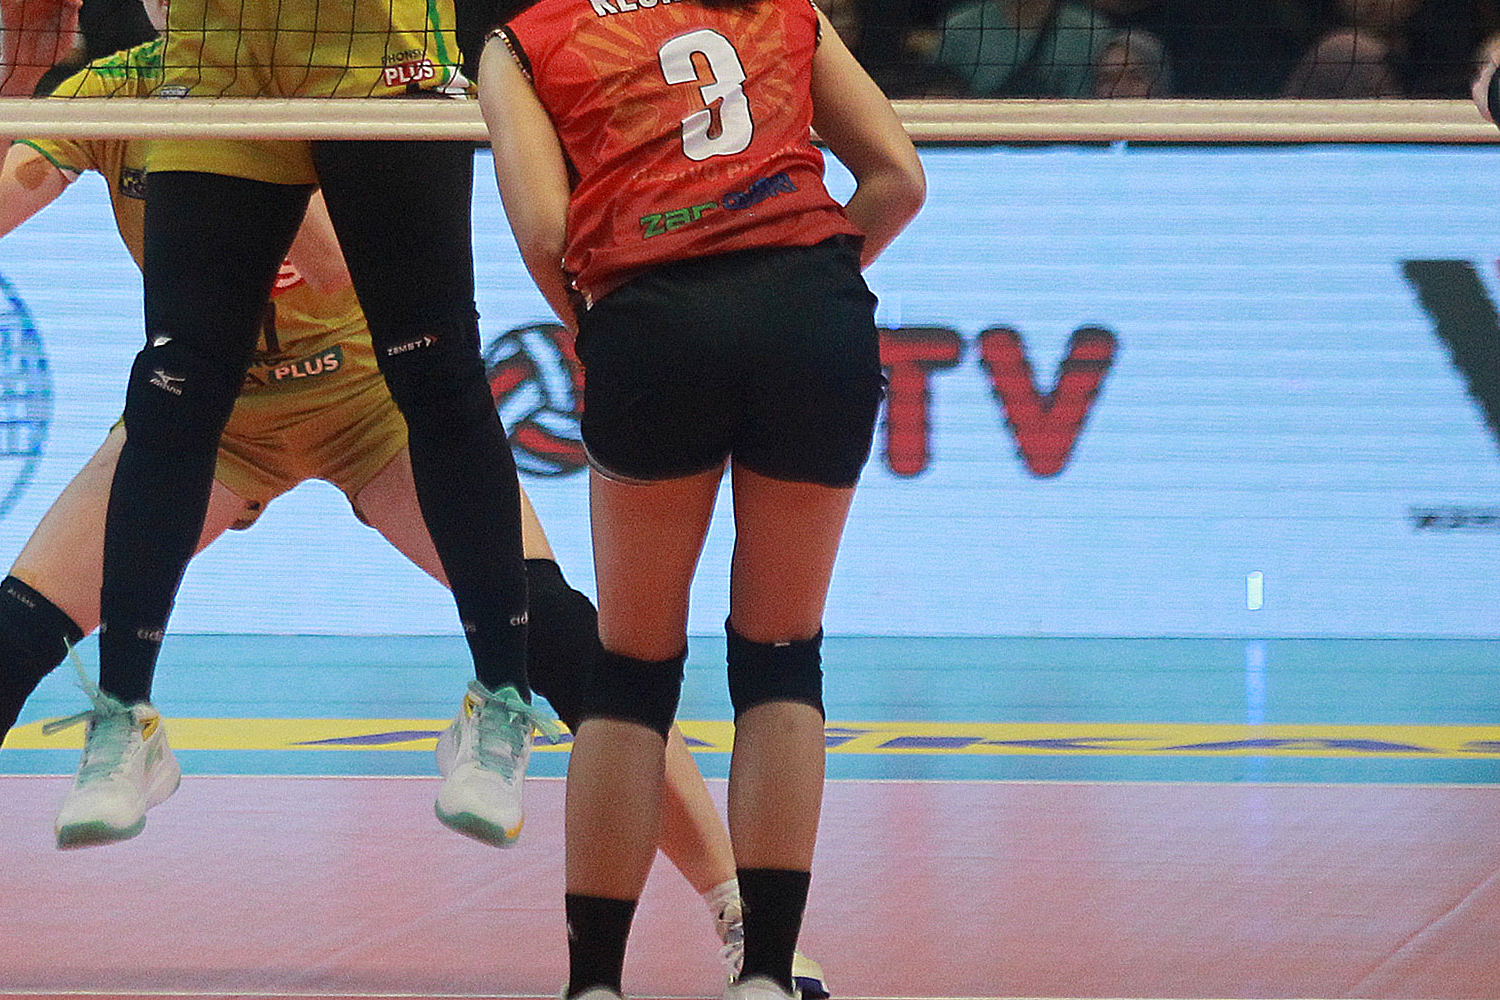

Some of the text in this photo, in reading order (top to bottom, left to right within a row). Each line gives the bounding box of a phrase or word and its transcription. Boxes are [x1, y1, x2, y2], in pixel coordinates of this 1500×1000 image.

[384, 60, 435, 86] PLUS
[658, 28, 754, 162] 3
[274, 353, 339, 380] PLUS
[879, 326, 1117, 476] TV
